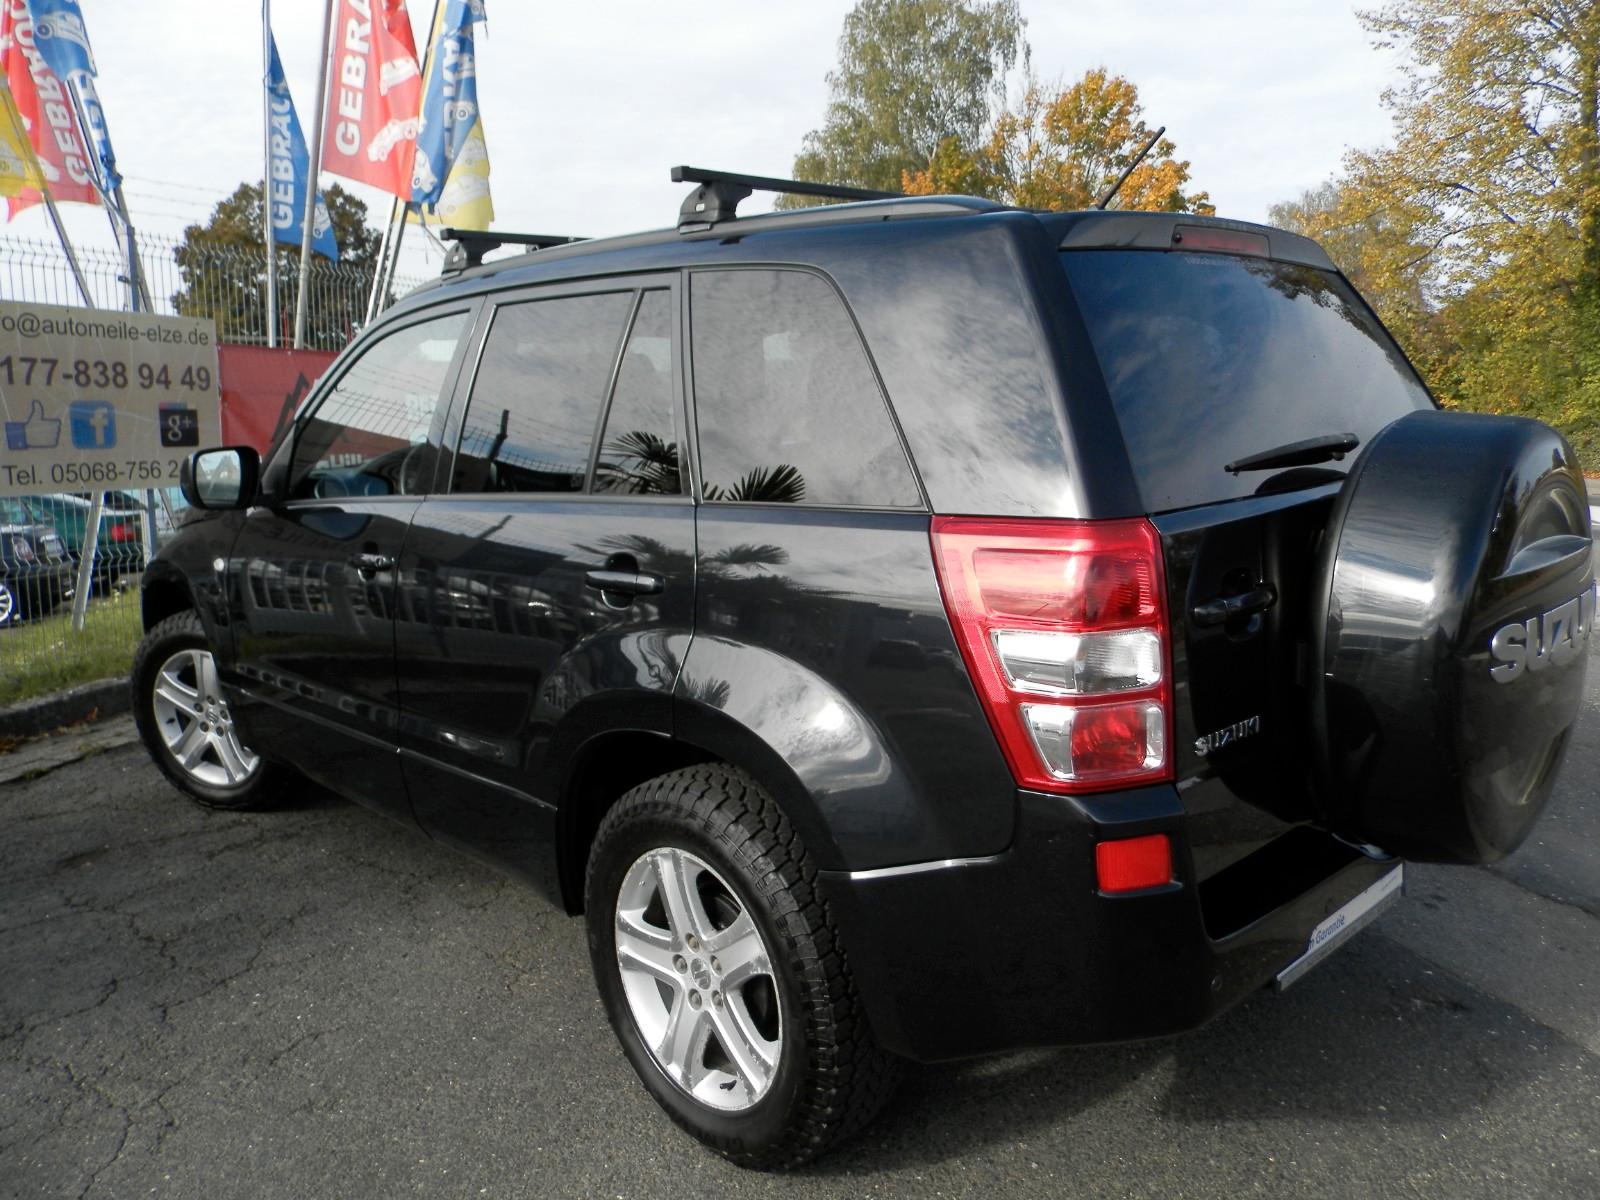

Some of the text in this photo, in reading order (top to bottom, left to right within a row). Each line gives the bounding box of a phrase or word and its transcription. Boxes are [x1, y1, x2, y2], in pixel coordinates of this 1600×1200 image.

[0, 355, 211, 392] 177-838 94 49
[1, 463, 43, 486] Tel.
[51, 460, 162, 485] 05068-756
[1194, 715, 1260, 757] SUZUKI
